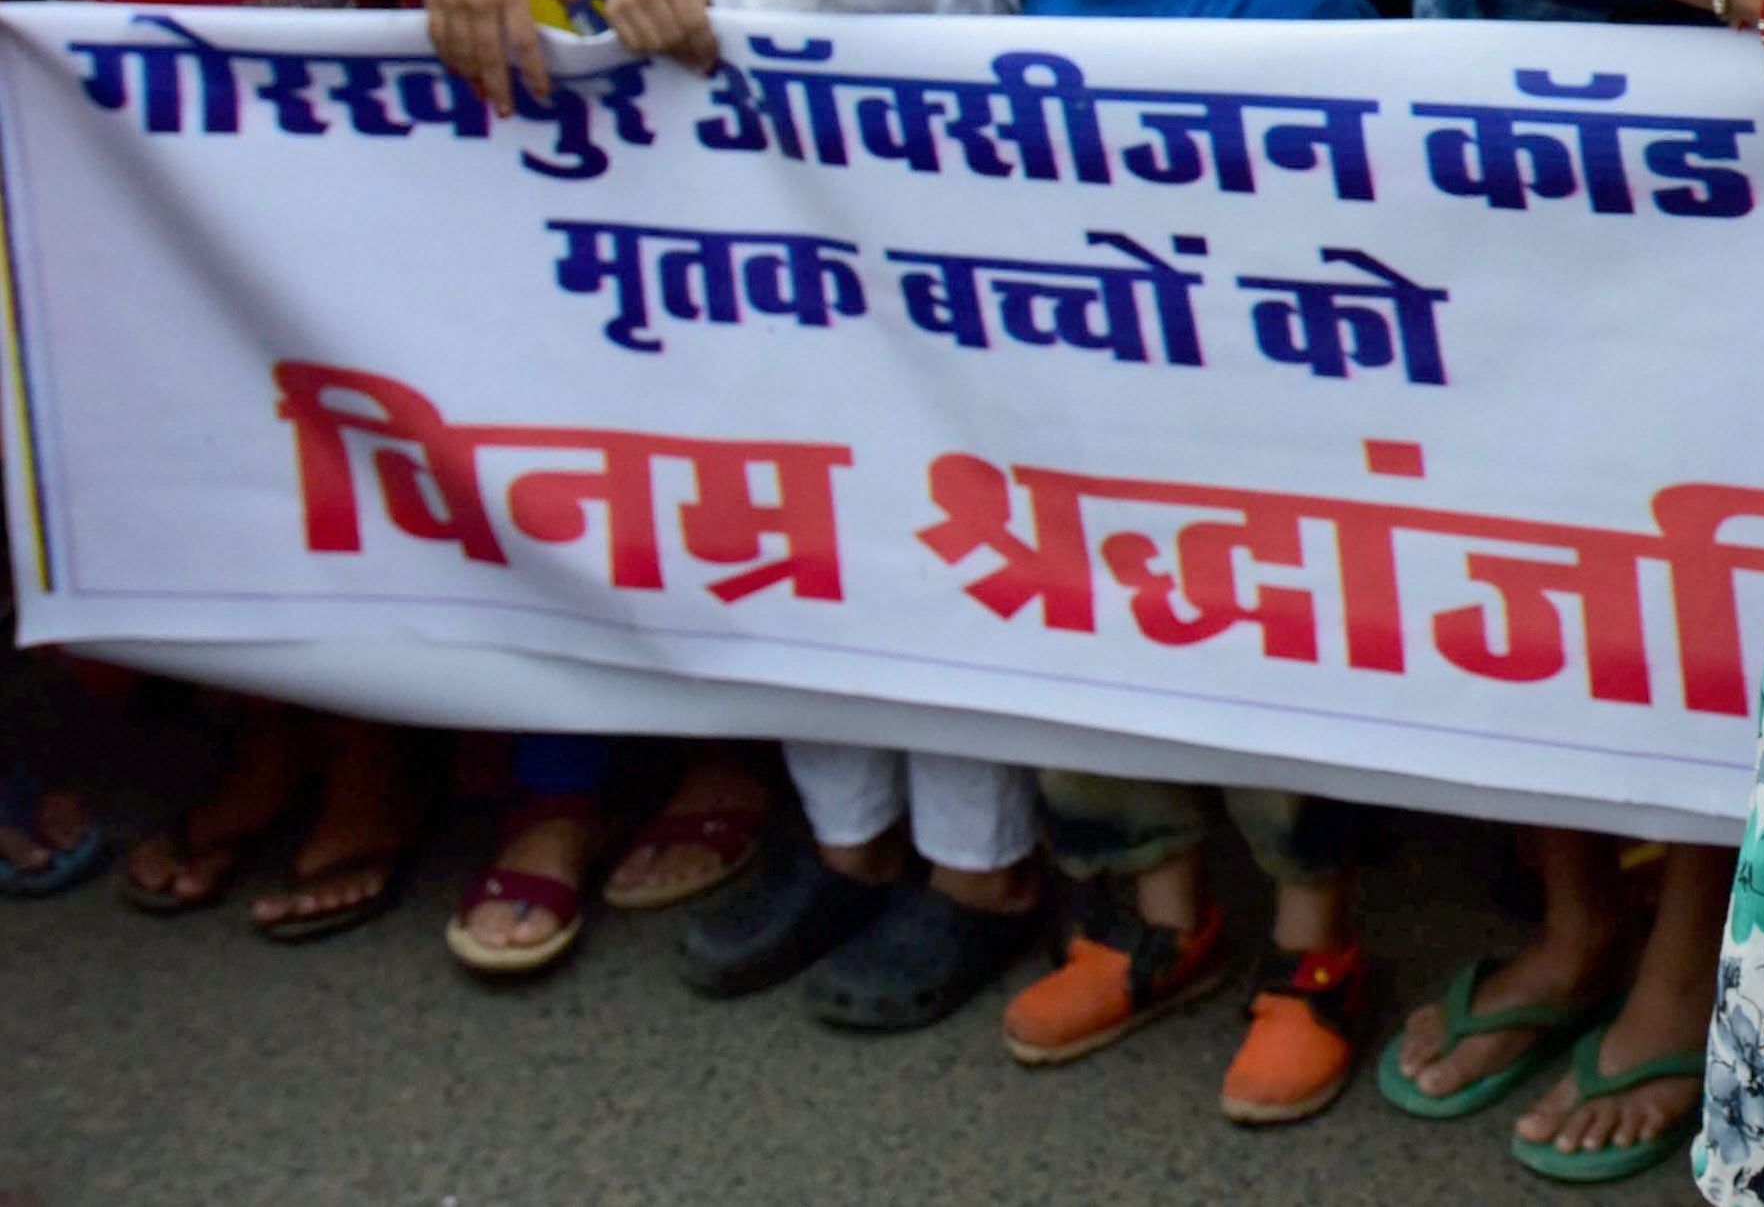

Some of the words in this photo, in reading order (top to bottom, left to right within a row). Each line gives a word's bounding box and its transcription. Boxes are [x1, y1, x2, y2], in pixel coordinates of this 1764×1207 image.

[69, 14, 656, 180] गोरखपुर
[694, 36, 1379, 202] ऑक्सीजन
[546, 219, 868, 353] मृतक
[886, 231, 1209, 367] बच्चों
[1237, 247, 1449, 386] को
[273, 360, 853, 604] विनम्र
